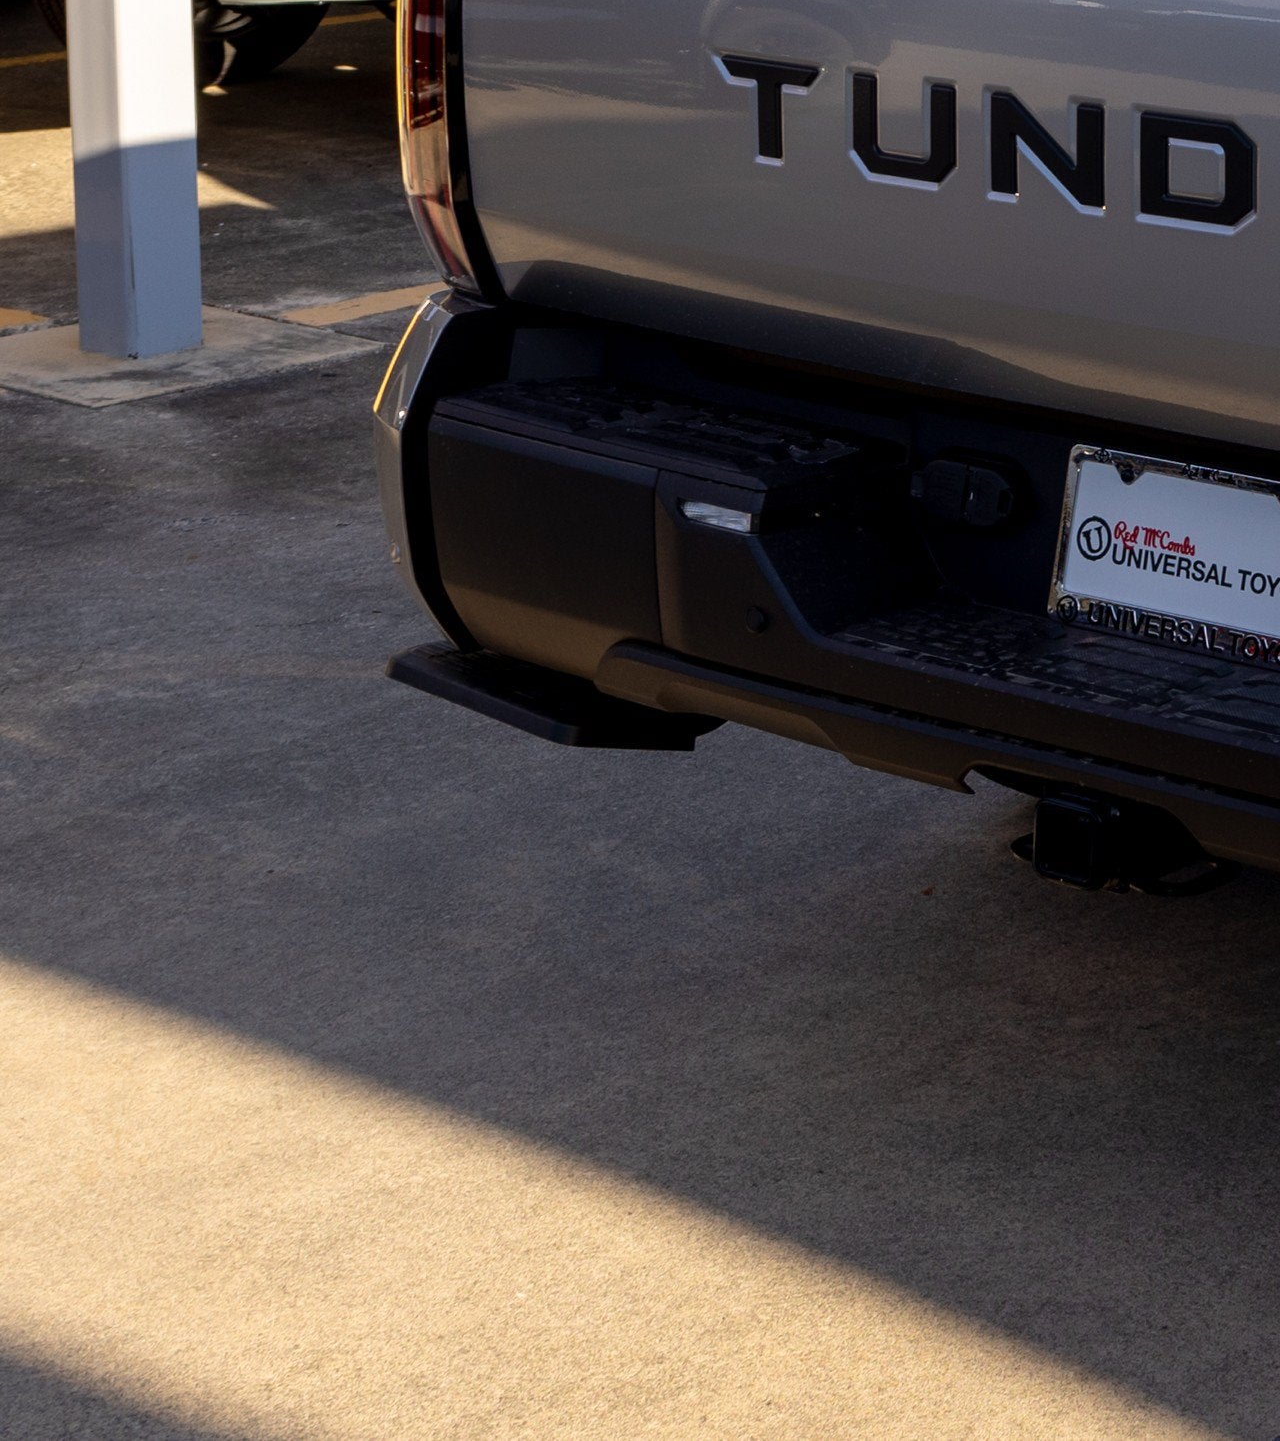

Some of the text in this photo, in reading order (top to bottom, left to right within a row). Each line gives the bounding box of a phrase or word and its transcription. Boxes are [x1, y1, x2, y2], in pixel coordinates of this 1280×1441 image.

[1114, 521, 1196, 557] Red McCombs
[1112, 543, 1233, 588] UNIVERSAL
[1087, 600, 1225, 653] UNIVERSAL
